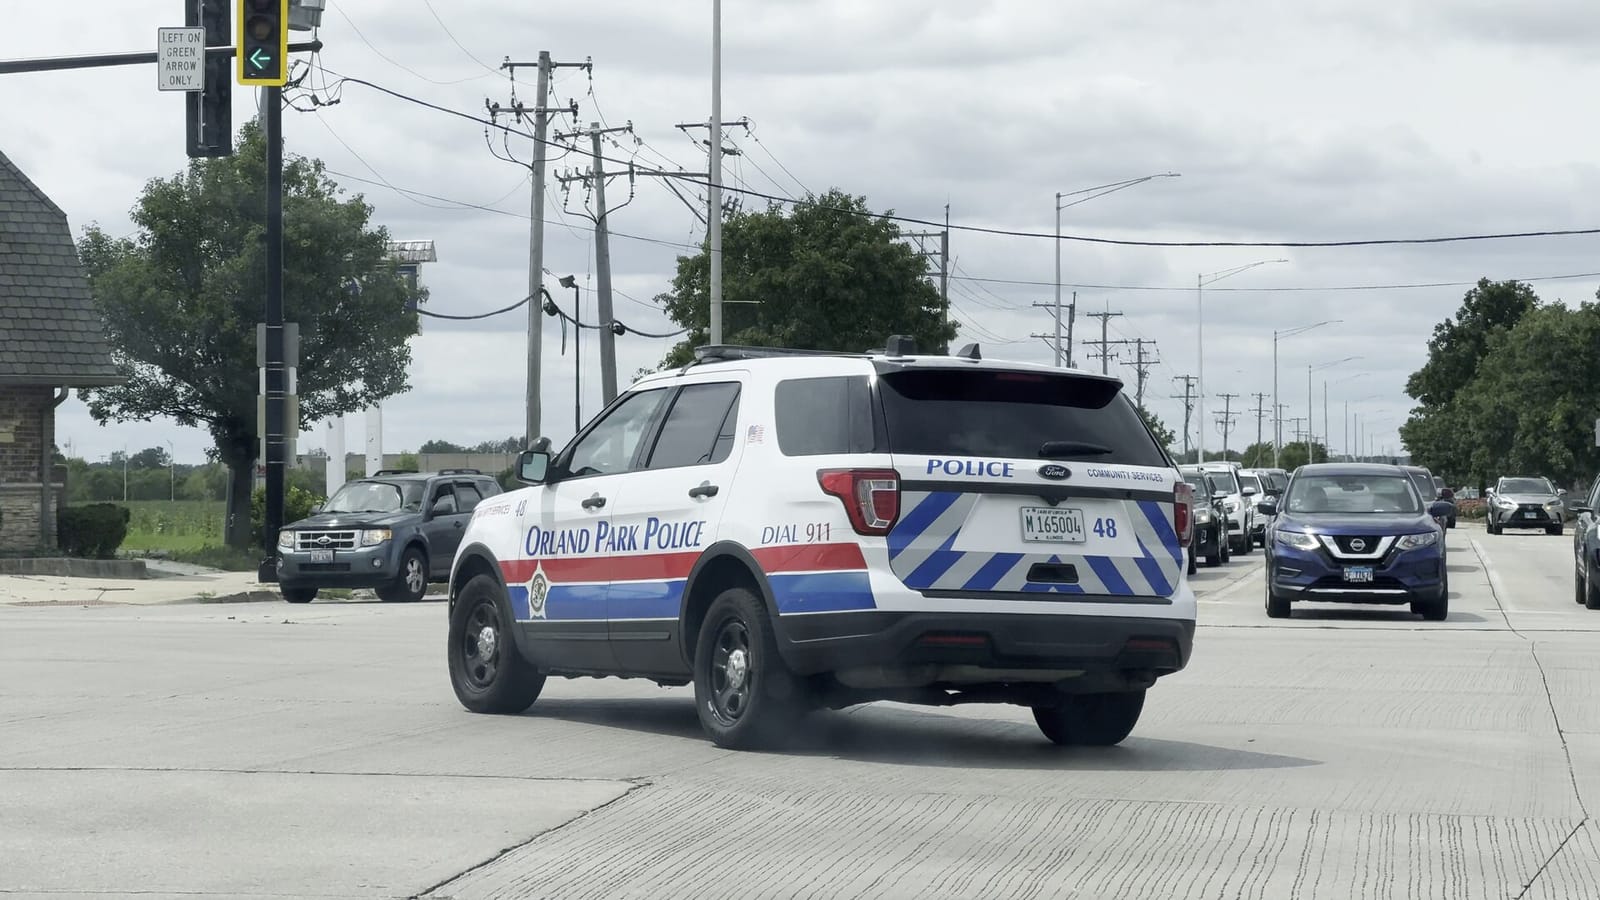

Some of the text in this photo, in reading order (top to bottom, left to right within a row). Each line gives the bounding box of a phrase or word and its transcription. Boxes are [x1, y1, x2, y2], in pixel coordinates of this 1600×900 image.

[162, 31, 201, 43] LEFT ON
[166, 46, 196, 57] GREEN
[165, 61, 197, 71] ARROW
[169, 75, 192, 85] ONLY
[926, 459, 1015, 478] POLICE
[1087, 468, 1163, 483] COMMUNITY SERVICES
[515, 499, 528, 517] 48
[761, 522, 830, 544] DIAL 911
[1037, 516, 1081, 534] 165004
[1093, 517, 1117, 538] 48
[525, 516, 707, 556] ORLAND PARK POLICE
